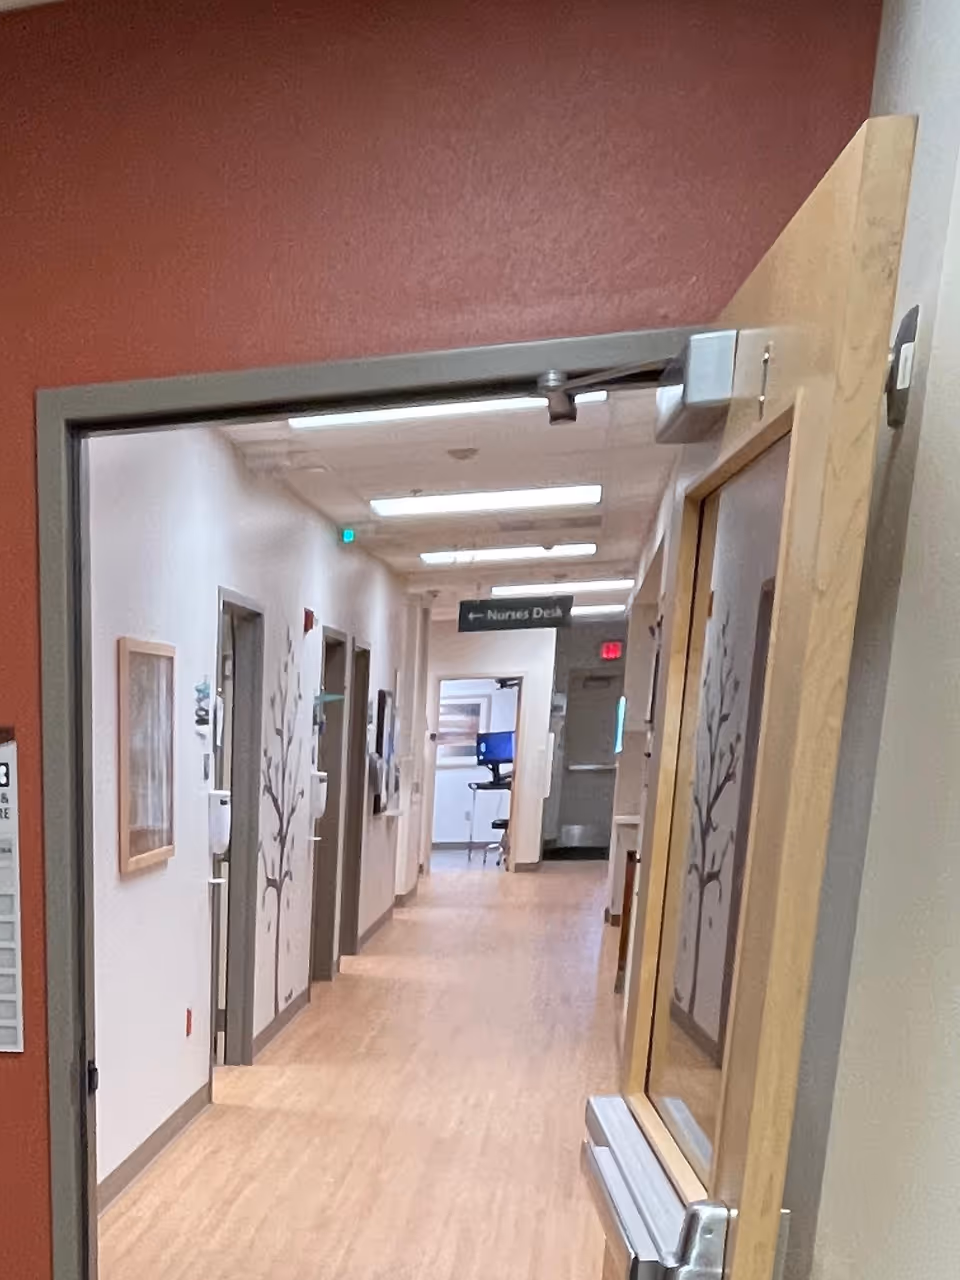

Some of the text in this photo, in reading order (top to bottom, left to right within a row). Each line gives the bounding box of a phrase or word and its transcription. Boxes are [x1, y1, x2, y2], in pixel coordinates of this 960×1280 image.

[487, 606, 563, 621] Nurses Desk
[0, 793, 9, 804] &
